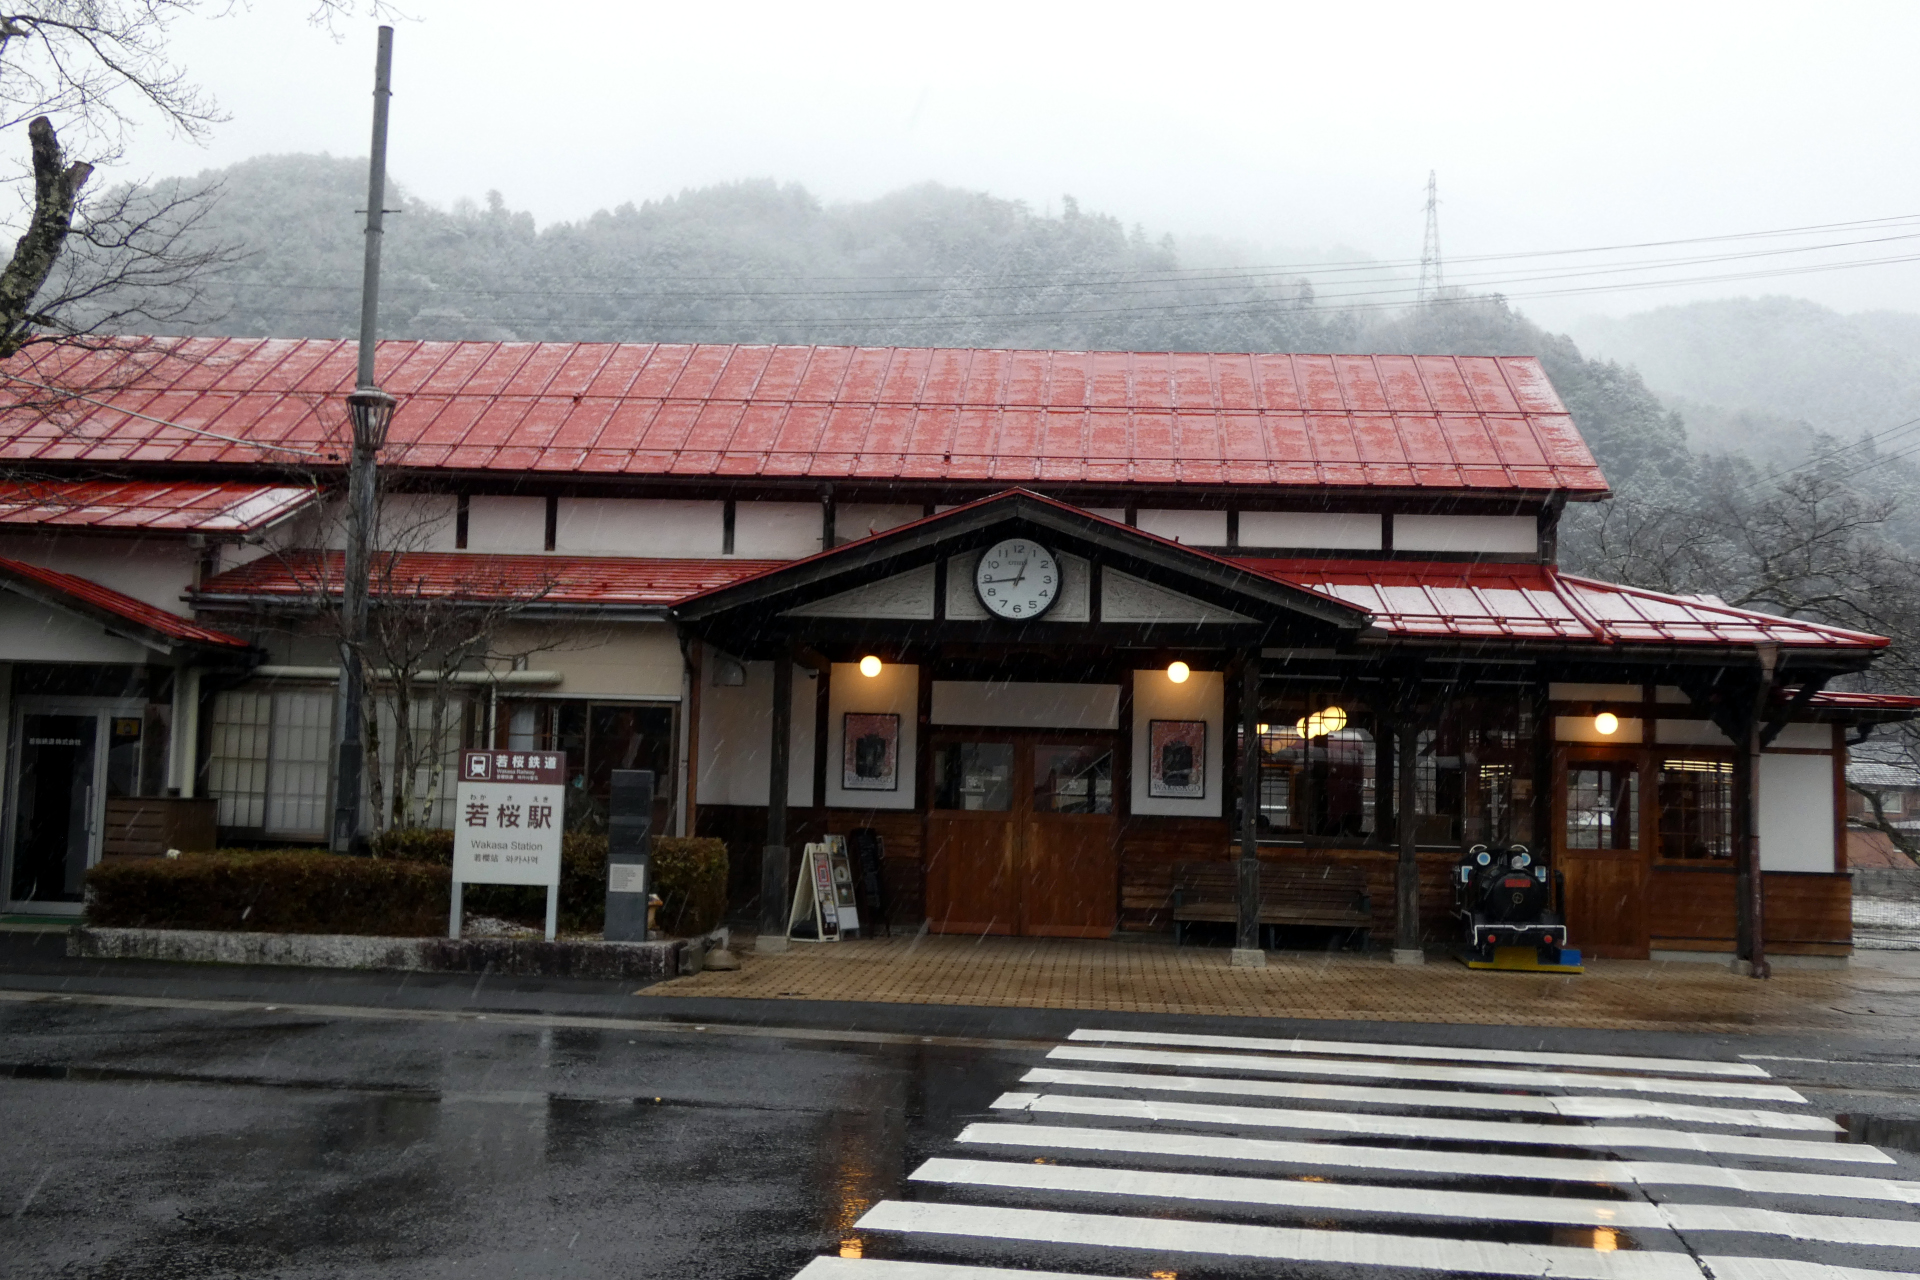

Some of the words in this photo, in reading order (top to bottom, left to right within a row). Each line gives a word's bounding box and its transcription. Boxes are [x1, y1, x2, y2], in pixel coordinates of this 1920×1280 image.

[998, 549, 1008, 558] 11
[1013, 545, 1025, 553] 12
[1032, 549, 1036, 557] 1
[988, 560, 999, 569] 10
[1040, 560, 1049, 569] 2
[984, 574, 992, 582] 9
[1043, 576, 1052, 584] 3
[987, 588, 996, 596] 8
[1039, 589, 1048, 598] 4
[999, 600, 1008, 608] 7
[1028, 600, 1037, 609] 5
[1013, 605, 1022, 613] 6
[496, 755, 557, 769] 若桜鉄道
[465, 802, 552, 830] 若桜駅
[470, 840, 508, 850] Wakasa
[510, 841, 543, 851] Station
